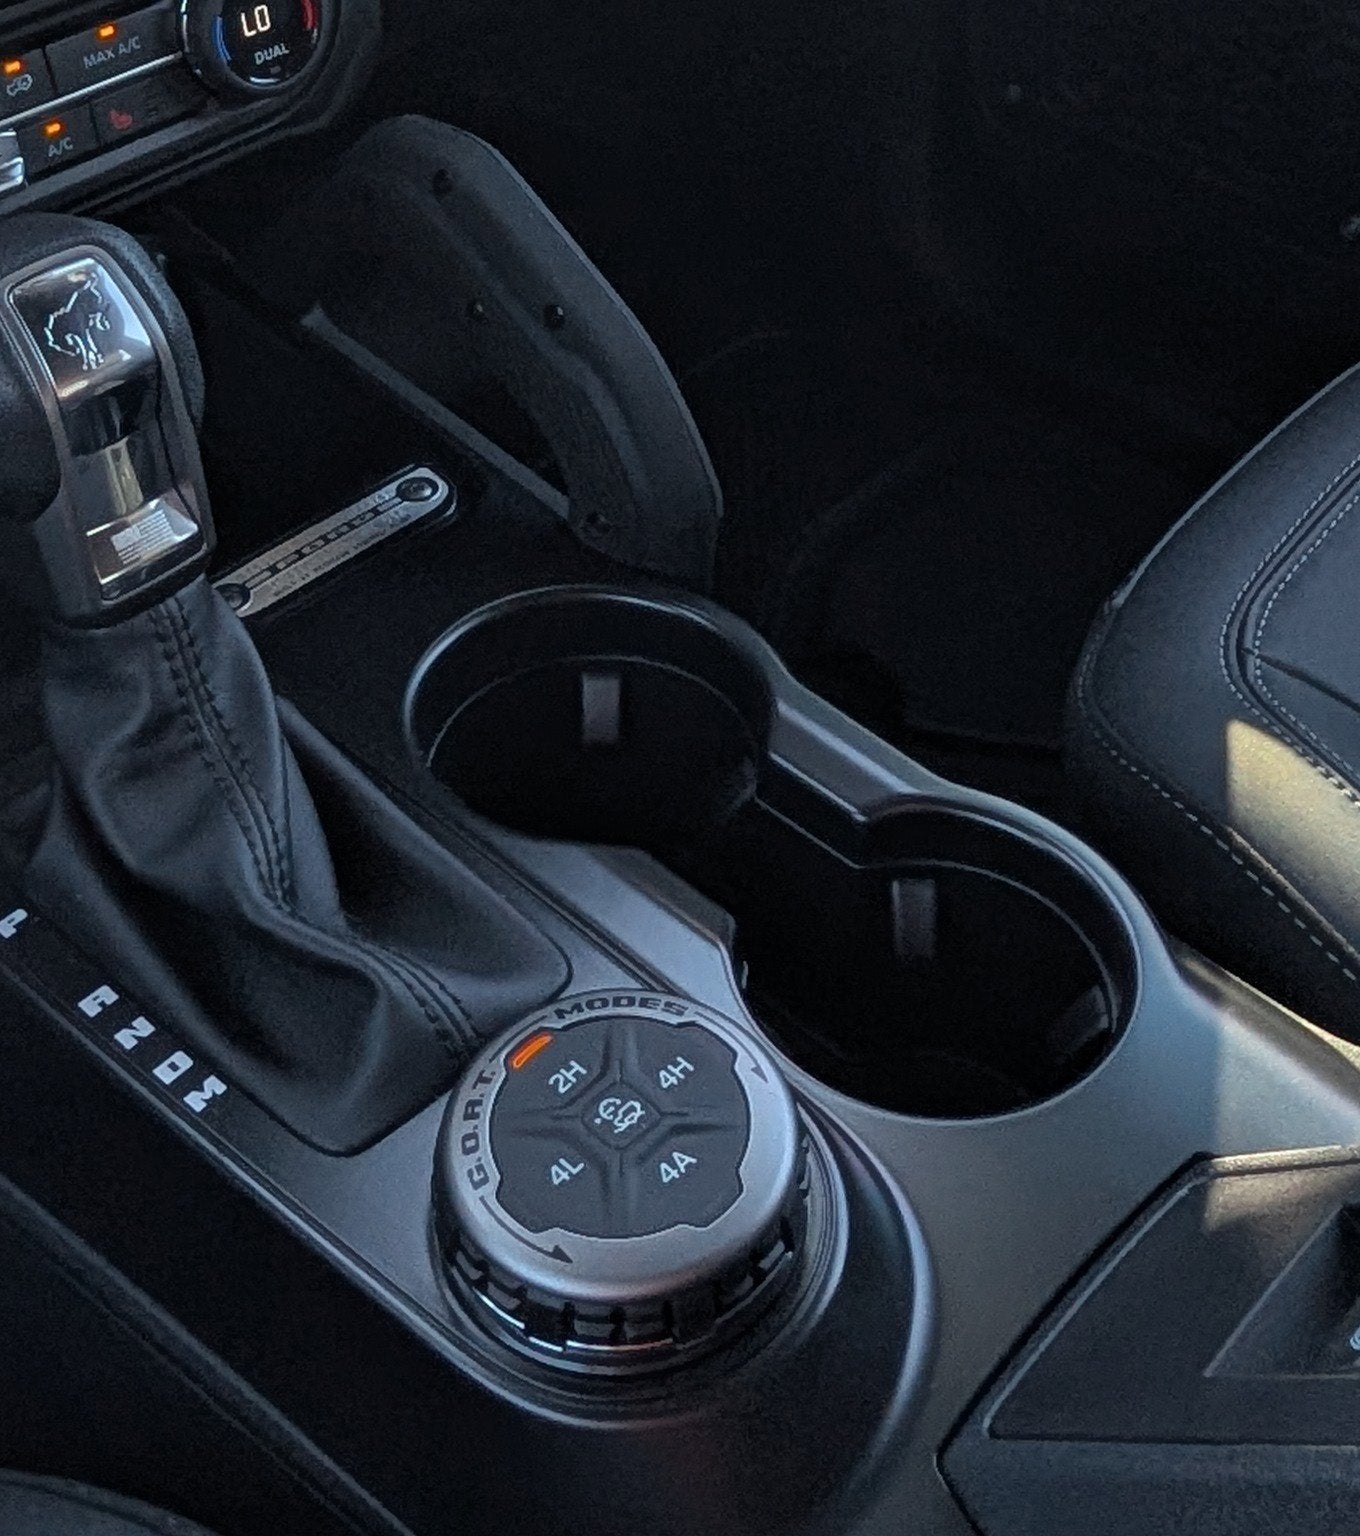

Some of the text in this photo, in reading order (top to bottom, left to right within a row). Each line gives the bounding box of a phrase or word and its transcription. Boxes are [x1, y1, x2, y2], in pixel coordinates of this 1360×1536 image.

[240, 4, 272, 38] LO
[83, 35, 142, 70] MAX A/C
[254, 43, 290, 66] DUAL
[48, 136, 74, 159] A/C
[553, 995, 689, 1020] MODES
[114, 1016, 156, 1050] N
[152, 1050, 194, 1085] D
[548, 1059, 588, 1094] 2H
[658, 1056, 695, 1090] 4H
[183, 1074, 228, 1113] M
[549, 1157, 585, 1186] 4L
[658, 1150, 698, 1184] 4A
